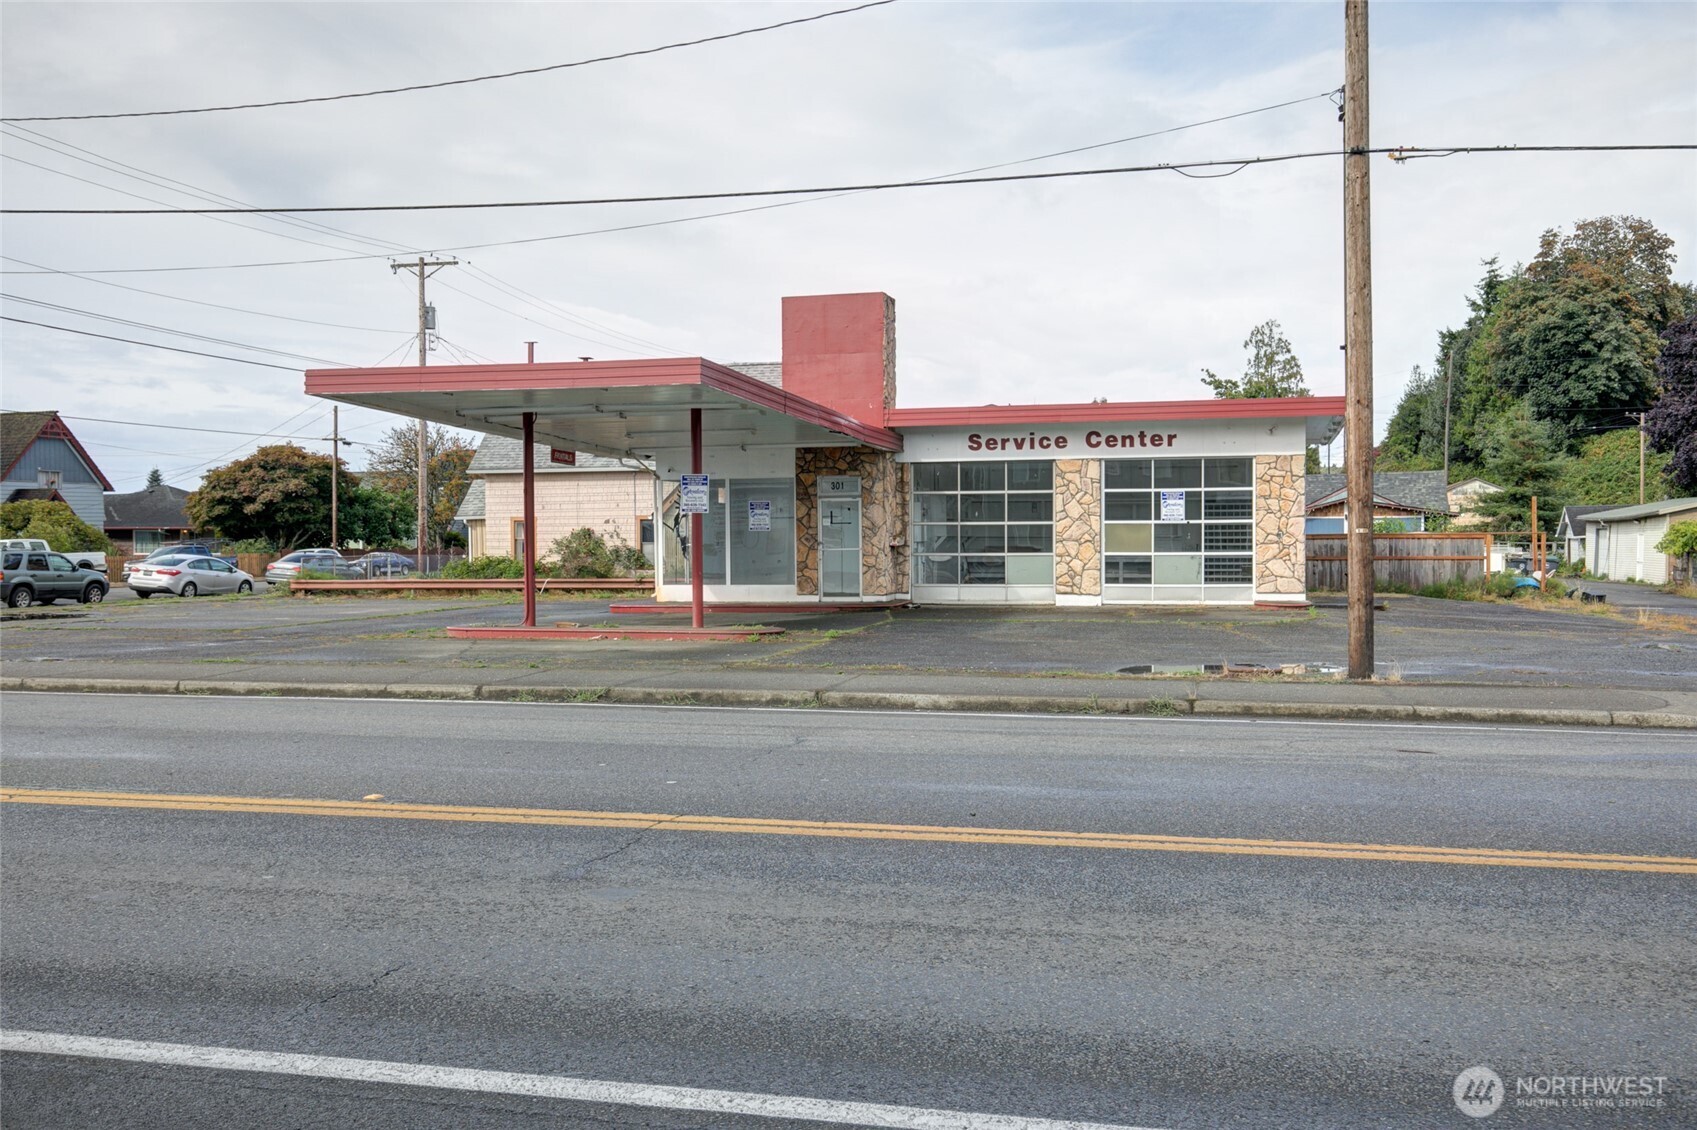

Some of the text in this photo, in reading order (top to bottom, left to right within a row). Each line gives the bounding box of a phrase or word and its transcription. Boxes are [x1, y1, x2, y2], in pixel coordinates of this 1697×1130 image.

[967, 430, 1177, 451] Service Center
[831, 481, 844, 490] 301
